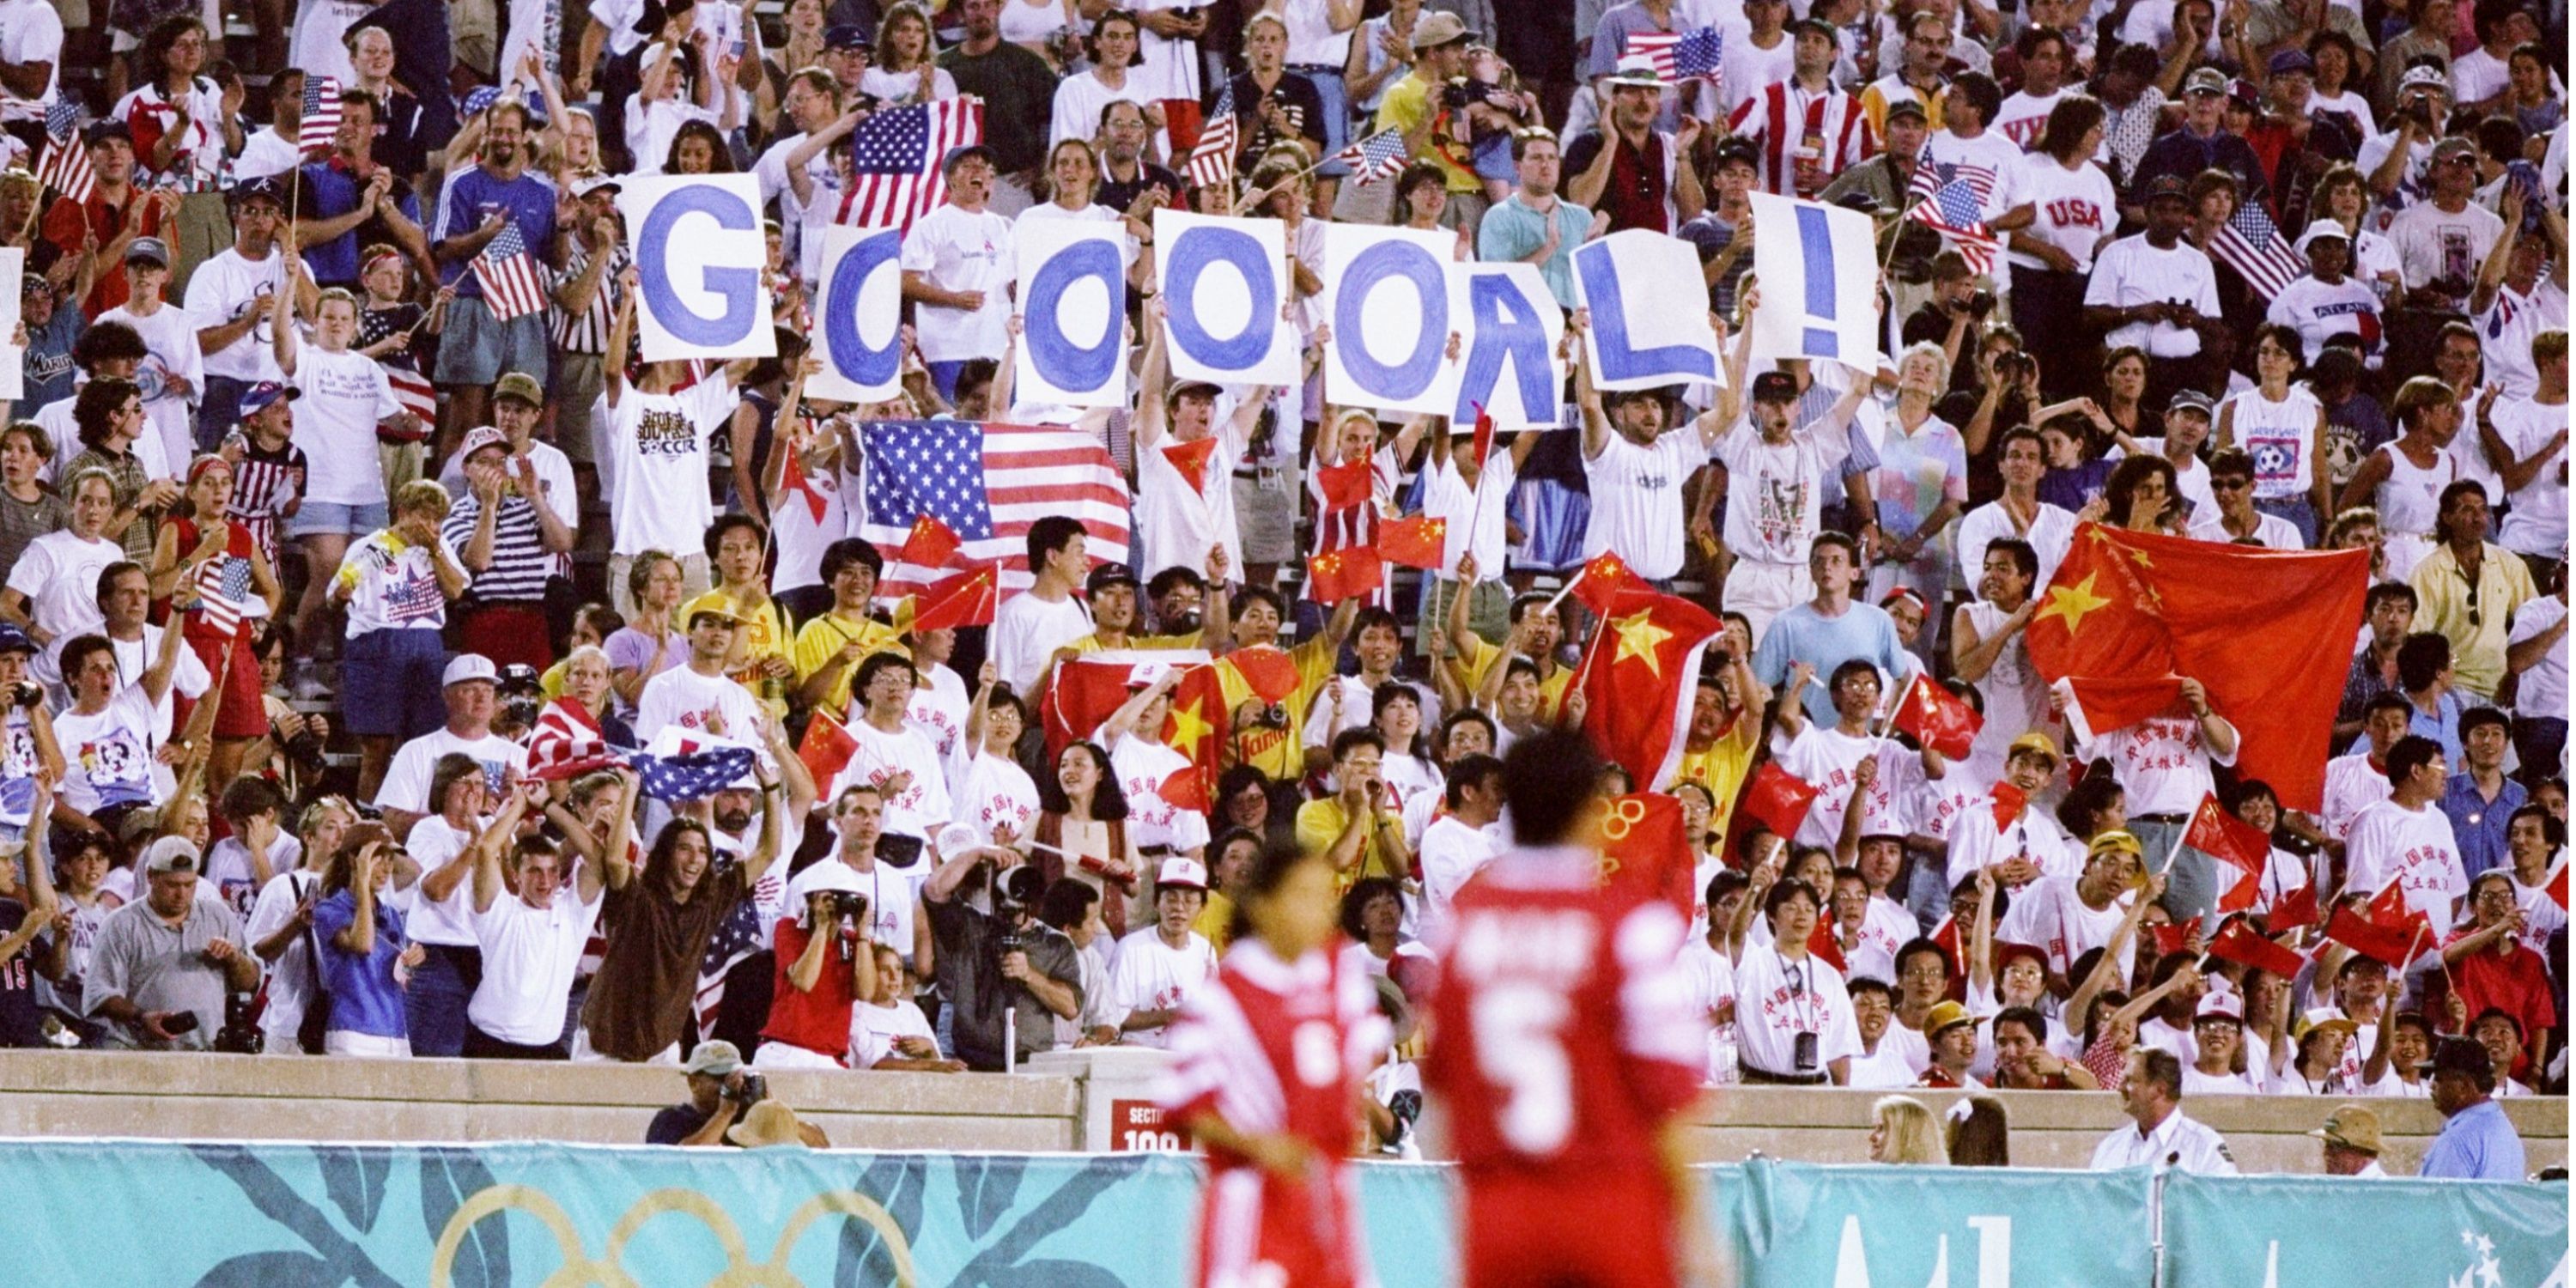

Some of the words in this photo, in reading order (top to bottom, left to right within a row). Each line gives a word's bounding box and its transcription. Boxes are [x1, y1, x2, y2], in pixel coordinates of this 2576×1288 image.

[2045, 197, 2104, 231] USA
[3, 958, 27, 990] 15
[1470, 982, 1575, 1155] 5
[1129, 1107, 1165, 1124] SECTI
